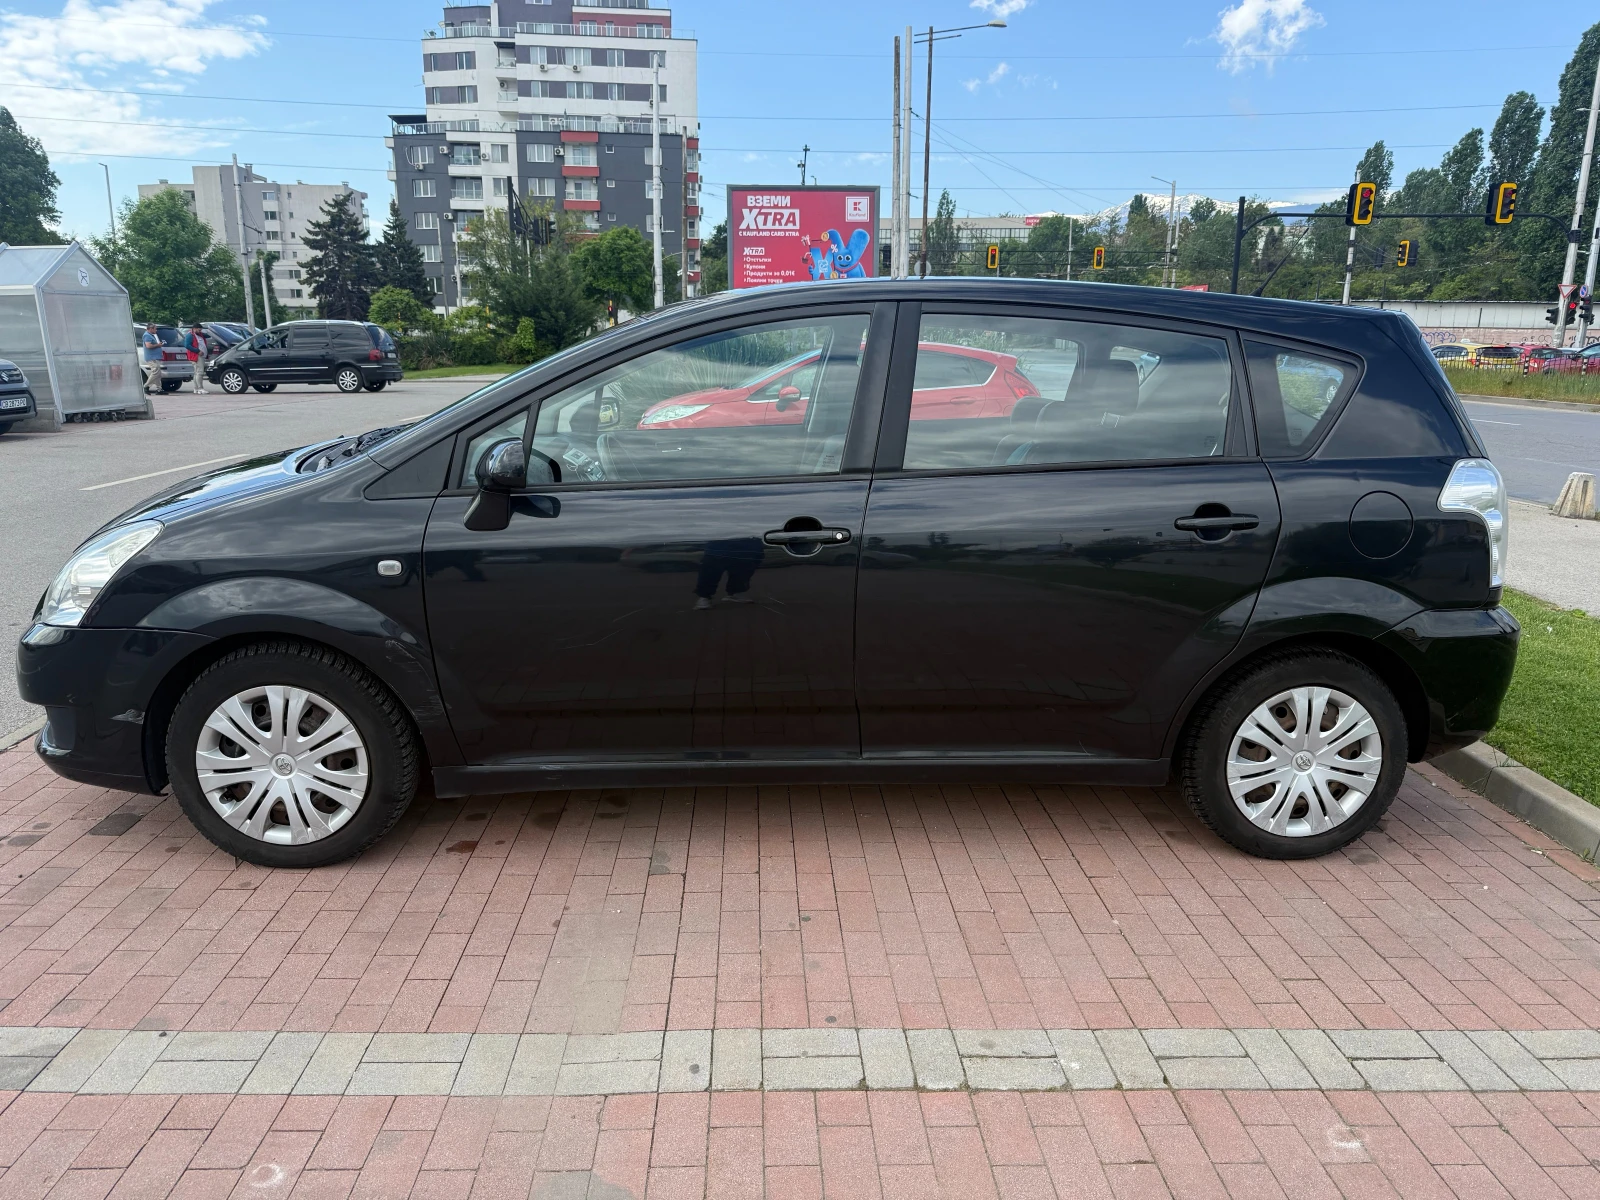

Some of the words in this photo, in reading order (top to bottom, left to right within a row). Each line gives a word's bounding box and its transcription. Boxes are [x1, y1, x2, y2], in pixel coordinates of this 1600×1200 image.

[747, 195, 791, 207] ВЗЕМИ
[739, 208, 800, 230] XTRA
[743, 247, 765, 256] XTRA
